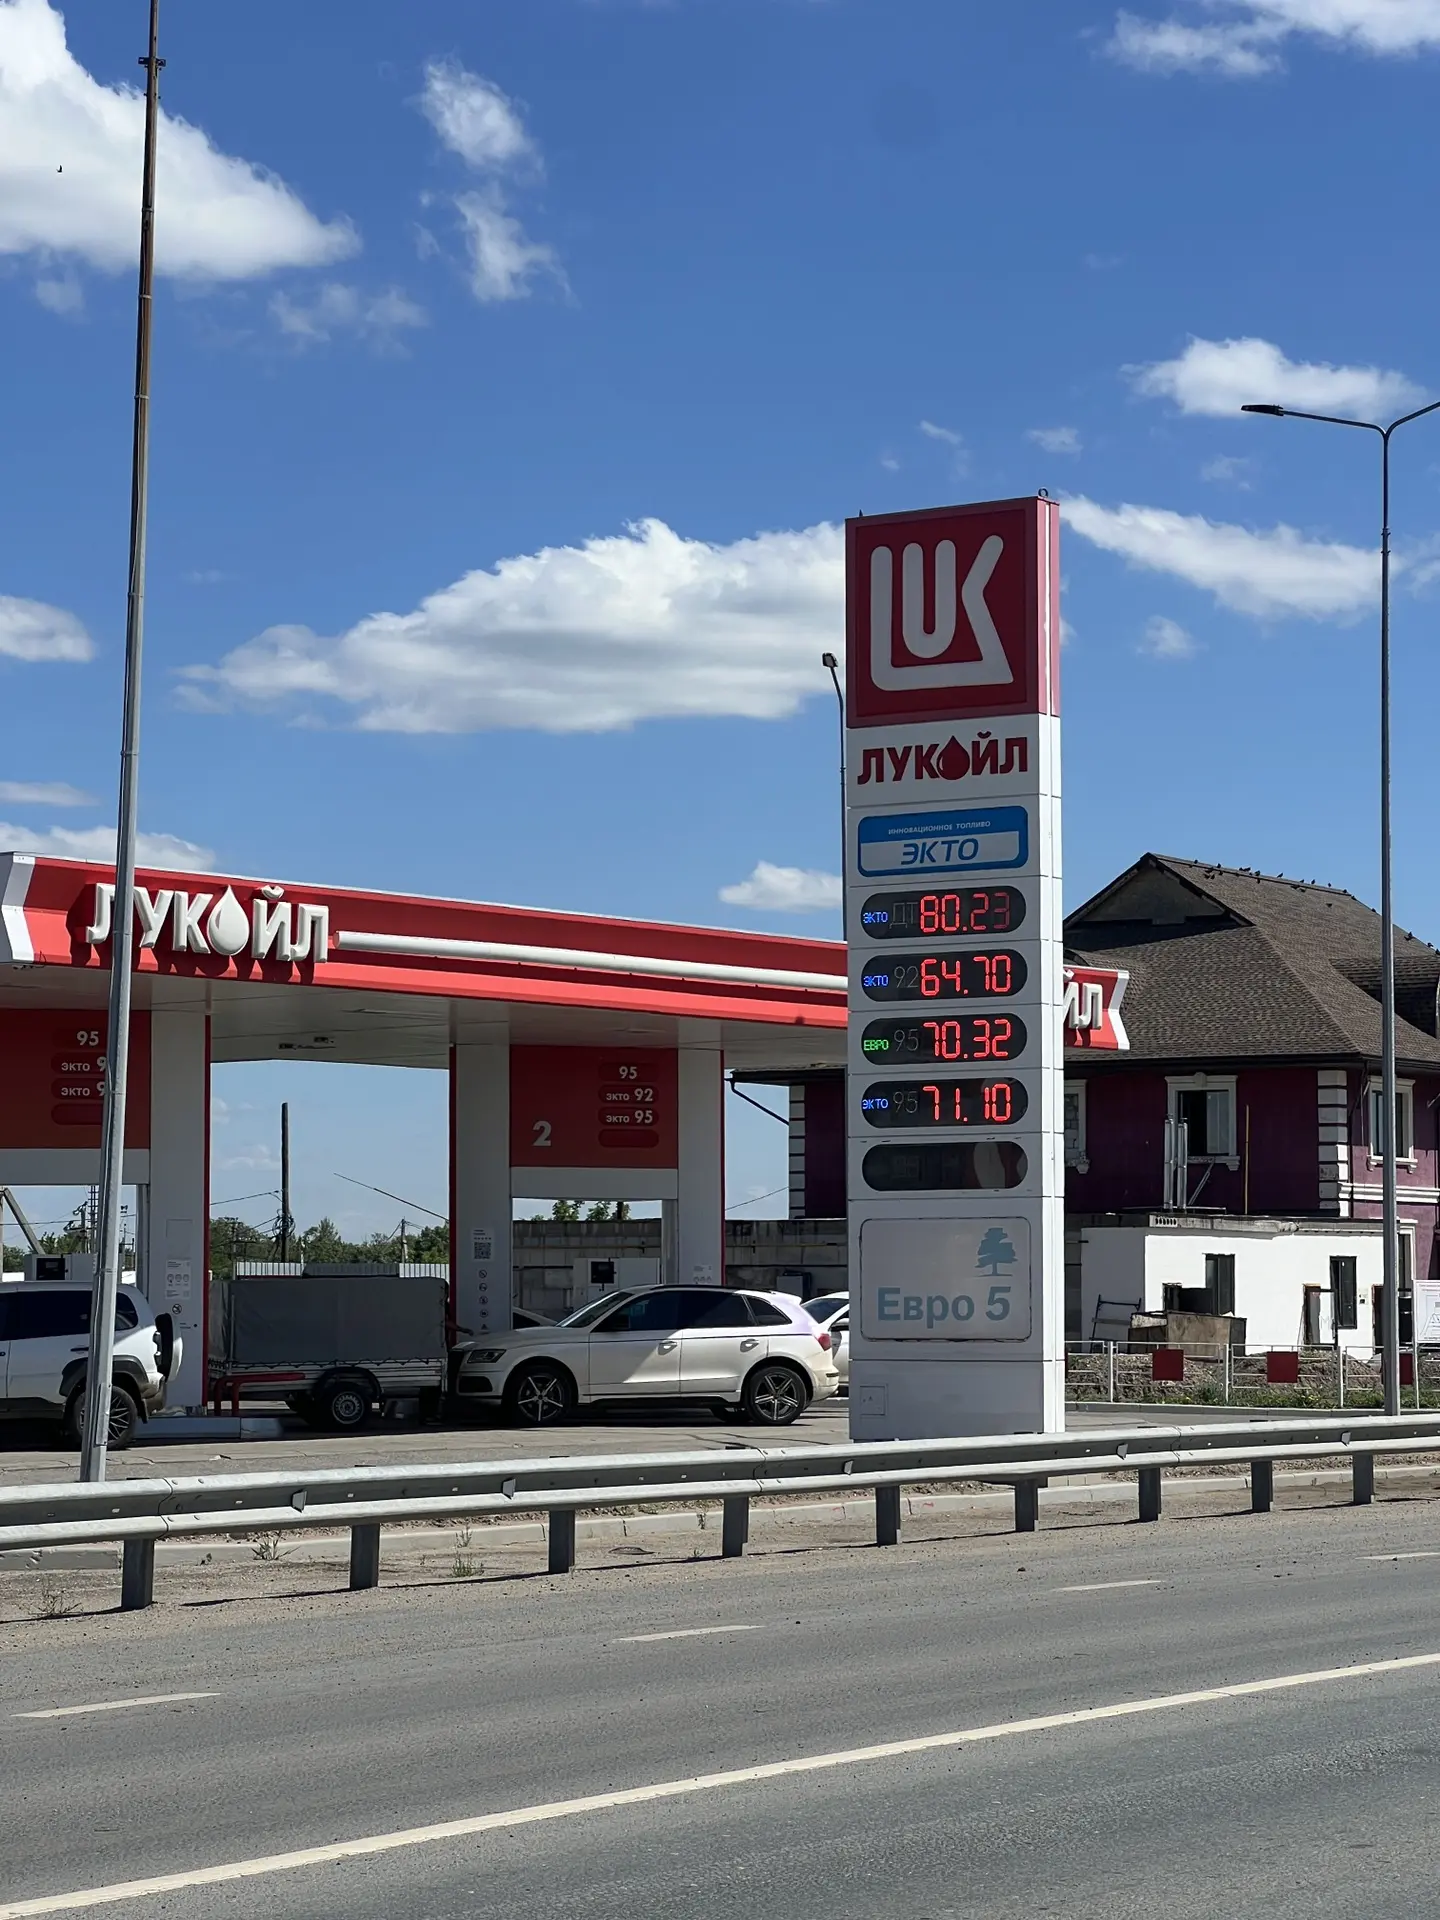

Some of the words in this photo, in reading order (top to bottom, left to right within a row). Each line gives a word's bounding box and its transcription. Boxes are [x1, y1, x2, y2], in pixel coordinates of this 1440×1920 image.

[857, 730, 1029, 785] ЛУКОЙЛ
[955, 820, 991, 830] ТОПЛИВО
[900, 838, 979, 866] ЭКТО
[862, 911, 889, 924] ЭКТО
[919, 892, 1010, 933] 80.23
[863, 975, 889, 987] ЭКТО
[893, 965, 920, 989] 92
[920, 955, 1012, 996] 64.70
[76, 1030, 100, 1046] 95
[863, 1039, 889, 1051] ЕВРО
[893, 1028, 920, 1052] 95
[922, 1018, 1012, 1059] 70.32
[618, 1065, 638, 1080] 95
[633, 1087, 654, 1103] 92
[862, 1098, 889, 1110] ЭКТО
[892, 1090, 919, 1114] 95
[922, 1083, 1012, 1122] 71.10
[634, 1109, 654, 1125] 95
[532, 1120, 552, 1147] 2
[877, 1286, 976, 1330] Евро
[985, 1285, 1012, 1322] 5
